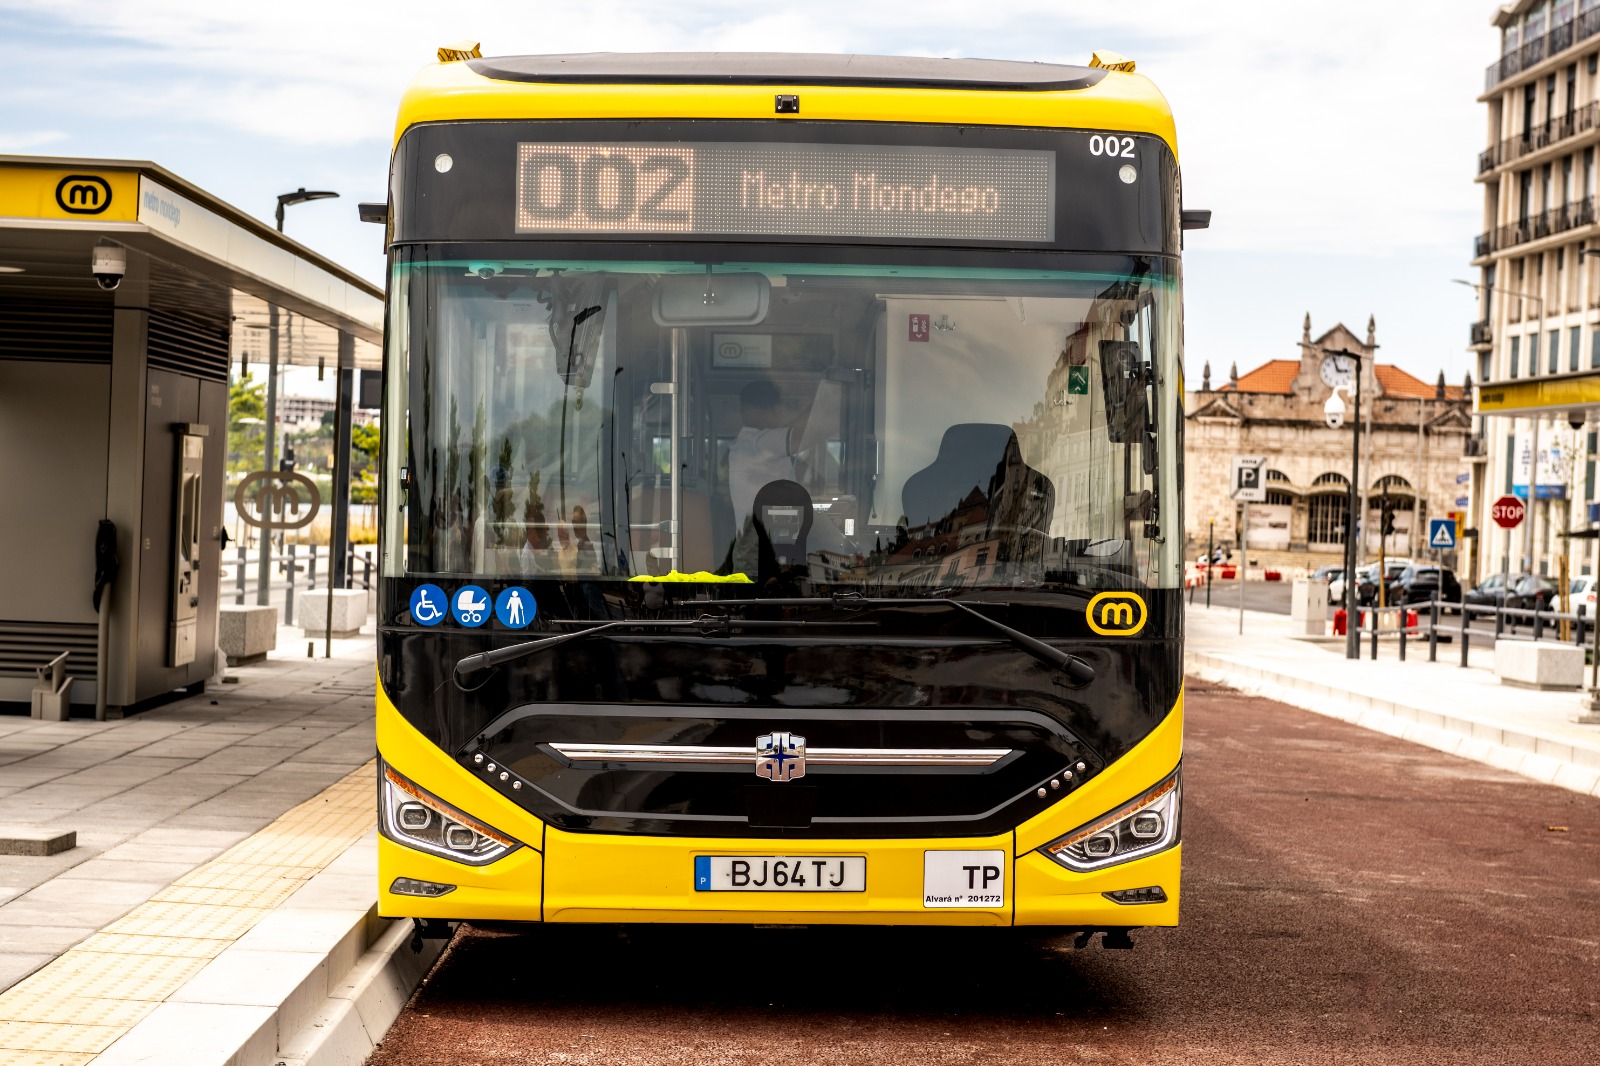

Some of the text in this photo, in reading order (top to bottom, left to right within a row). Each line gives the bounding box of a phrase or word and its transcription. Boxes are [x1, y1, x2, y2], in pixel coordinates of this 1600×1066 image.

[1089, 135, 1135, 158] 002
[522, 153, 998, 223] 002 Metro Mondego
[1241, 468, 1256, 487] P
[1492, 505, 1523, 519] STOP
[700, 877, 707, 885] P
[962, 865, 1000, 889] TP
[925, 895, 952, 903] Alvará
[967, 895, 1001, 903] 201272
